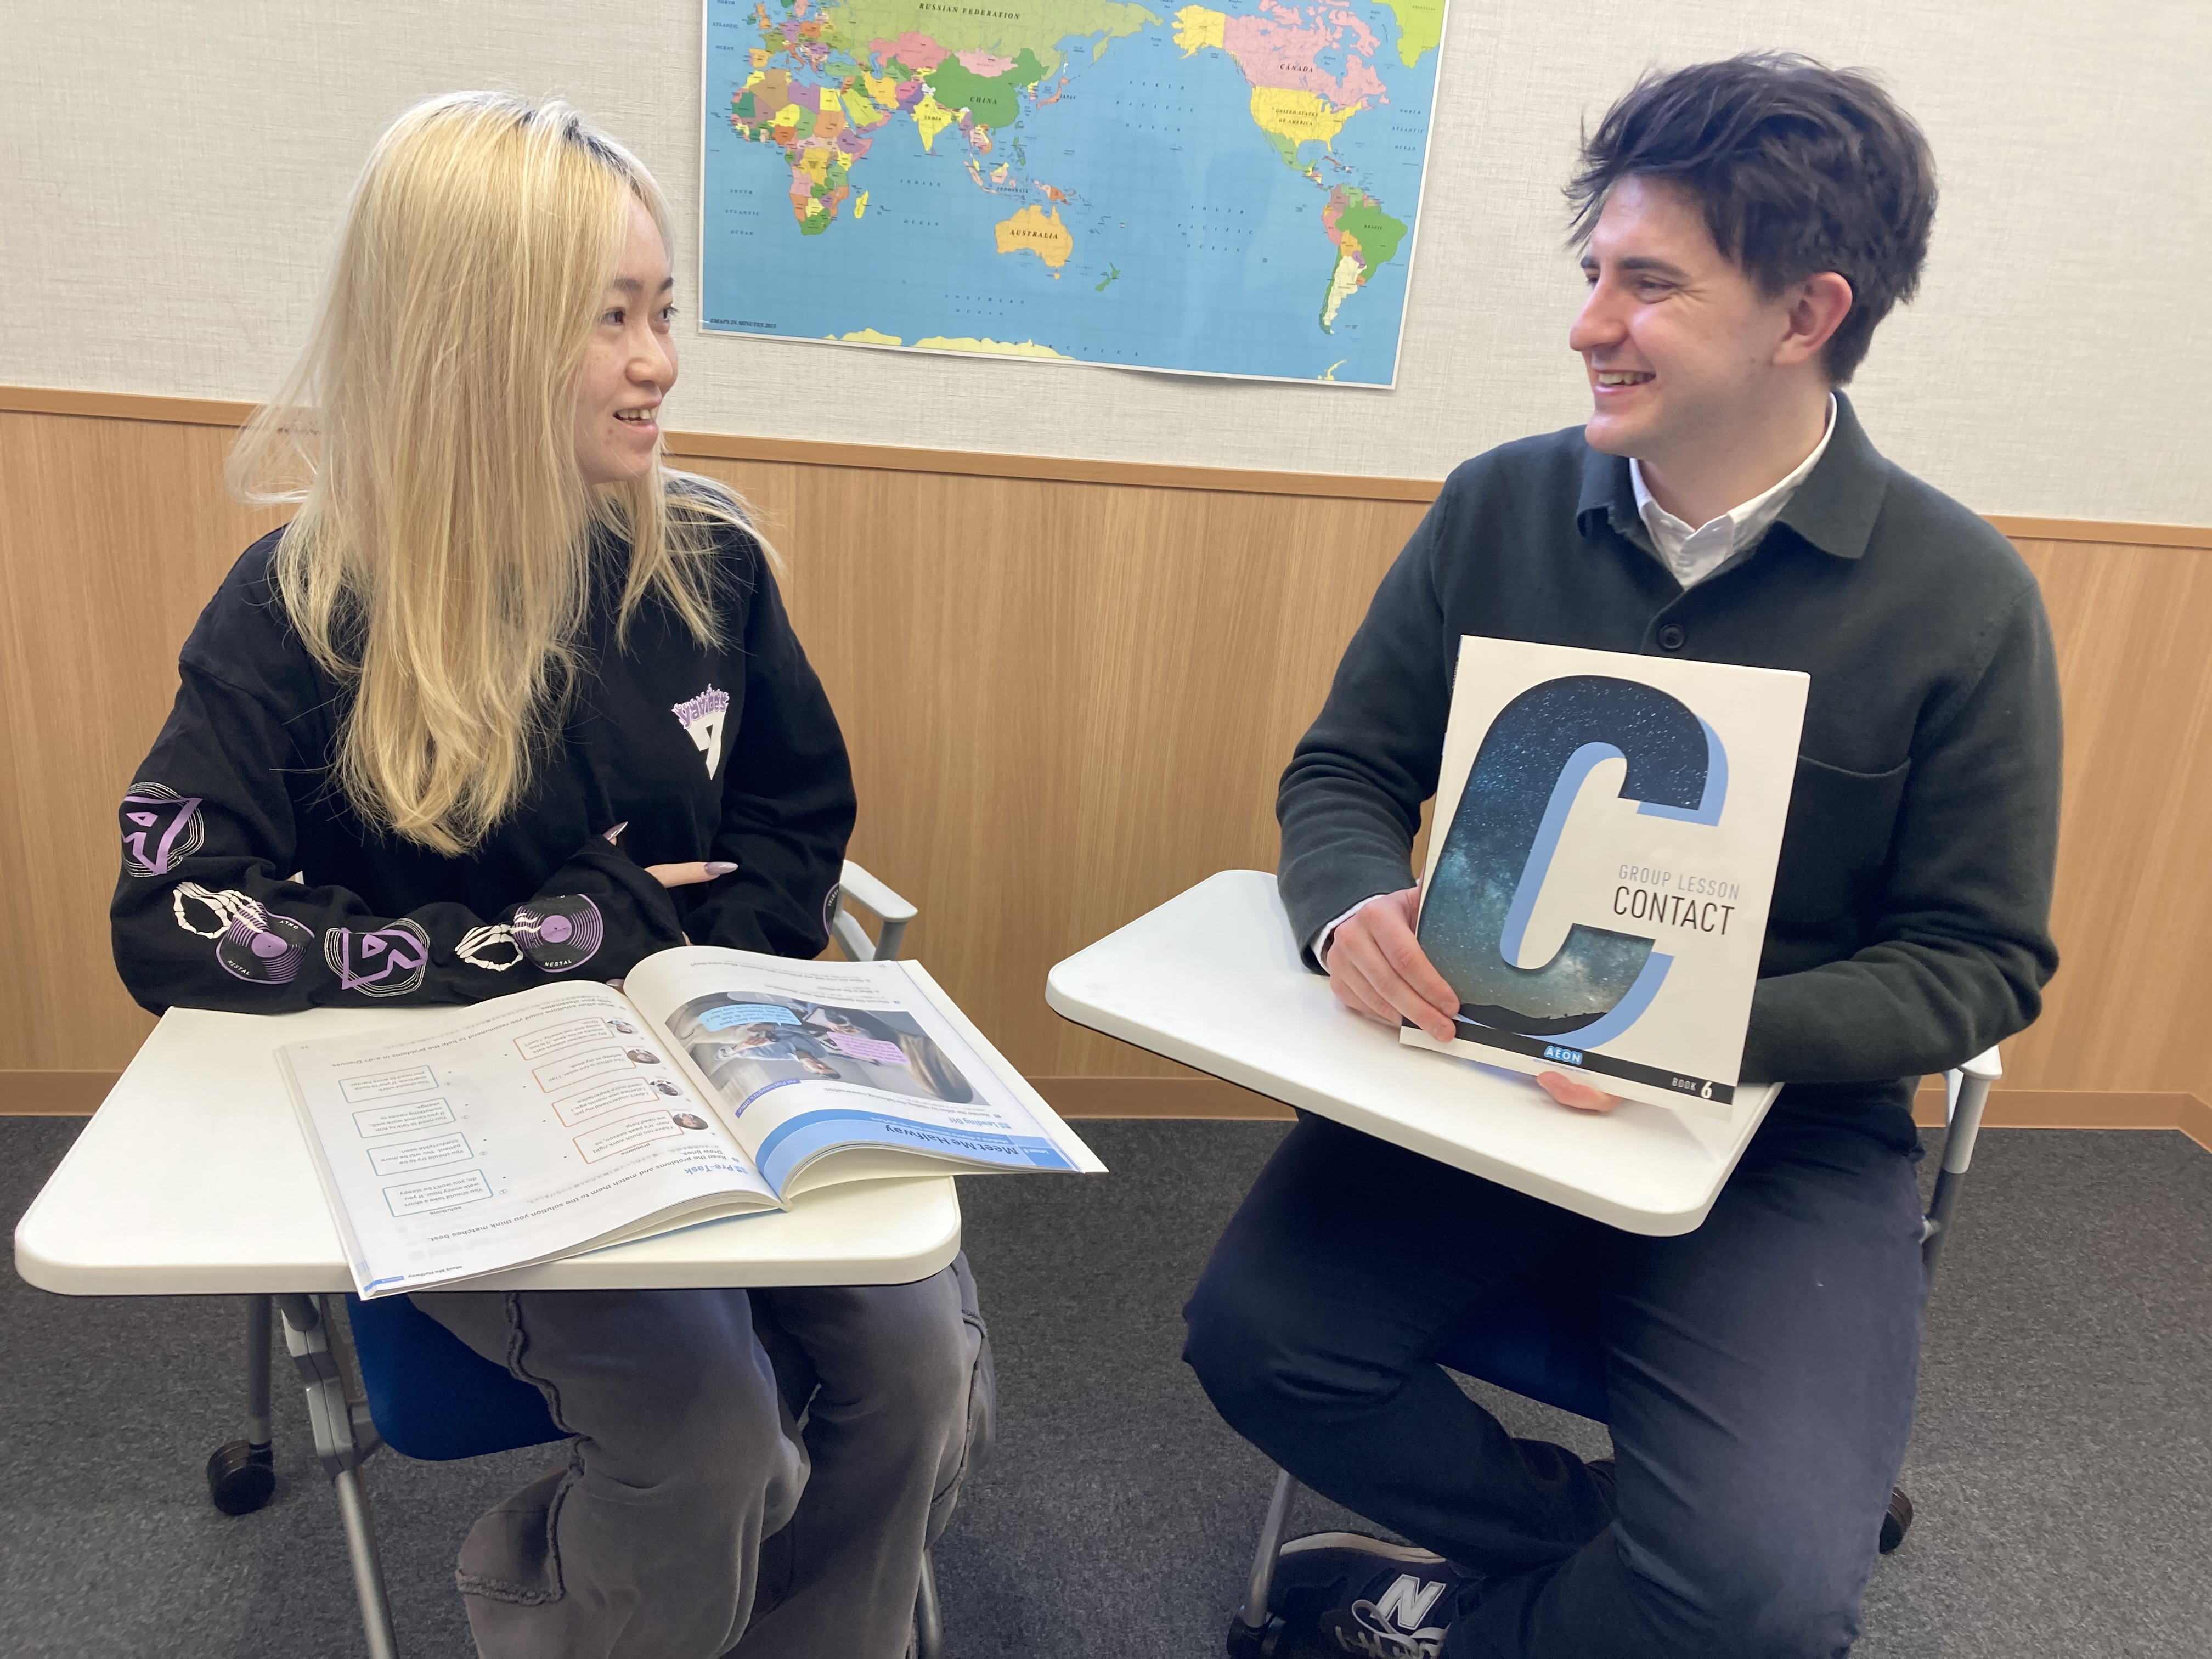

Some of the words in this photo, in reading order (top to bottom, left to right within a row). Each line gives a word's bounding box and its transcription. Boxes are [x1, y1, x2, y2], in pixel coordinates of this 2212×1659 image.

[919, 3, 958, 12] RUSSIAN
[962, 8, 1019, 20] FEDERATION
[1280, 64, 1313, 72] CANADA
[969, 96, 997, 104] CHINA
[1116, 100, 1193, 113] PACIFIC
[1125, 123, 1181, 132] OCEAN
[1009, 229, 1058, 239] AUSTRALIA
[1178, 223, 1252, 234] PACIFIC
[1187, 244, 1239, 252] OCEAN
[1619, 864, 1671, 886] GROUP
[1678, 874, 1740, 900] LESSON
[1614, 886, 1735, 935] CONTACT
[279, 920, 299, 929] ONLY
[228, 960, 250, 975] NESTAL
[544, 959, 572, 967] NESTAL
[545, 1005, 576, 1013] solutions
[467, 1023, 509, 1039] recommend
[392, 1047, 426, 1057] problems
[1545, 1046, 1582, 1064] AEON
[750, 1081, 786, 1099] Psychologist's
[1672, 1077, 1696, 1091] BOOK
[1701, 1081, 1713, 1099] 6
[408, 1107, 442, 1115] something
[738, 1099, 751, 1113] Office
[948, 1116, 963, 1125] Off
[961, 1117, 999, 1128] Leading
[885, 1125, 951, 1146] Halfway
[418, 1139, 458, 1150] comfortable
[620, 1143, 650, 1155] problems
[951, 1138, 976, 1150] Me
[976, 1143, 1019, 1155] Meet
[655, 1156, 691, 1169] problems
[639, 1167, 653, 1176] and
[684, 1164, 736, 1175] Pre-Task
[612, 1173, 637, 1185] match
[590, 1184, 611, 1194] them
[430, 1206, 461, 1215] solutions
[531, 1203, 563, 1216] solution
[490, 1220, 512, 1228] think
[451, 1225, 488, 1236] matches
[1370, 1574, 1447, 1630] N
